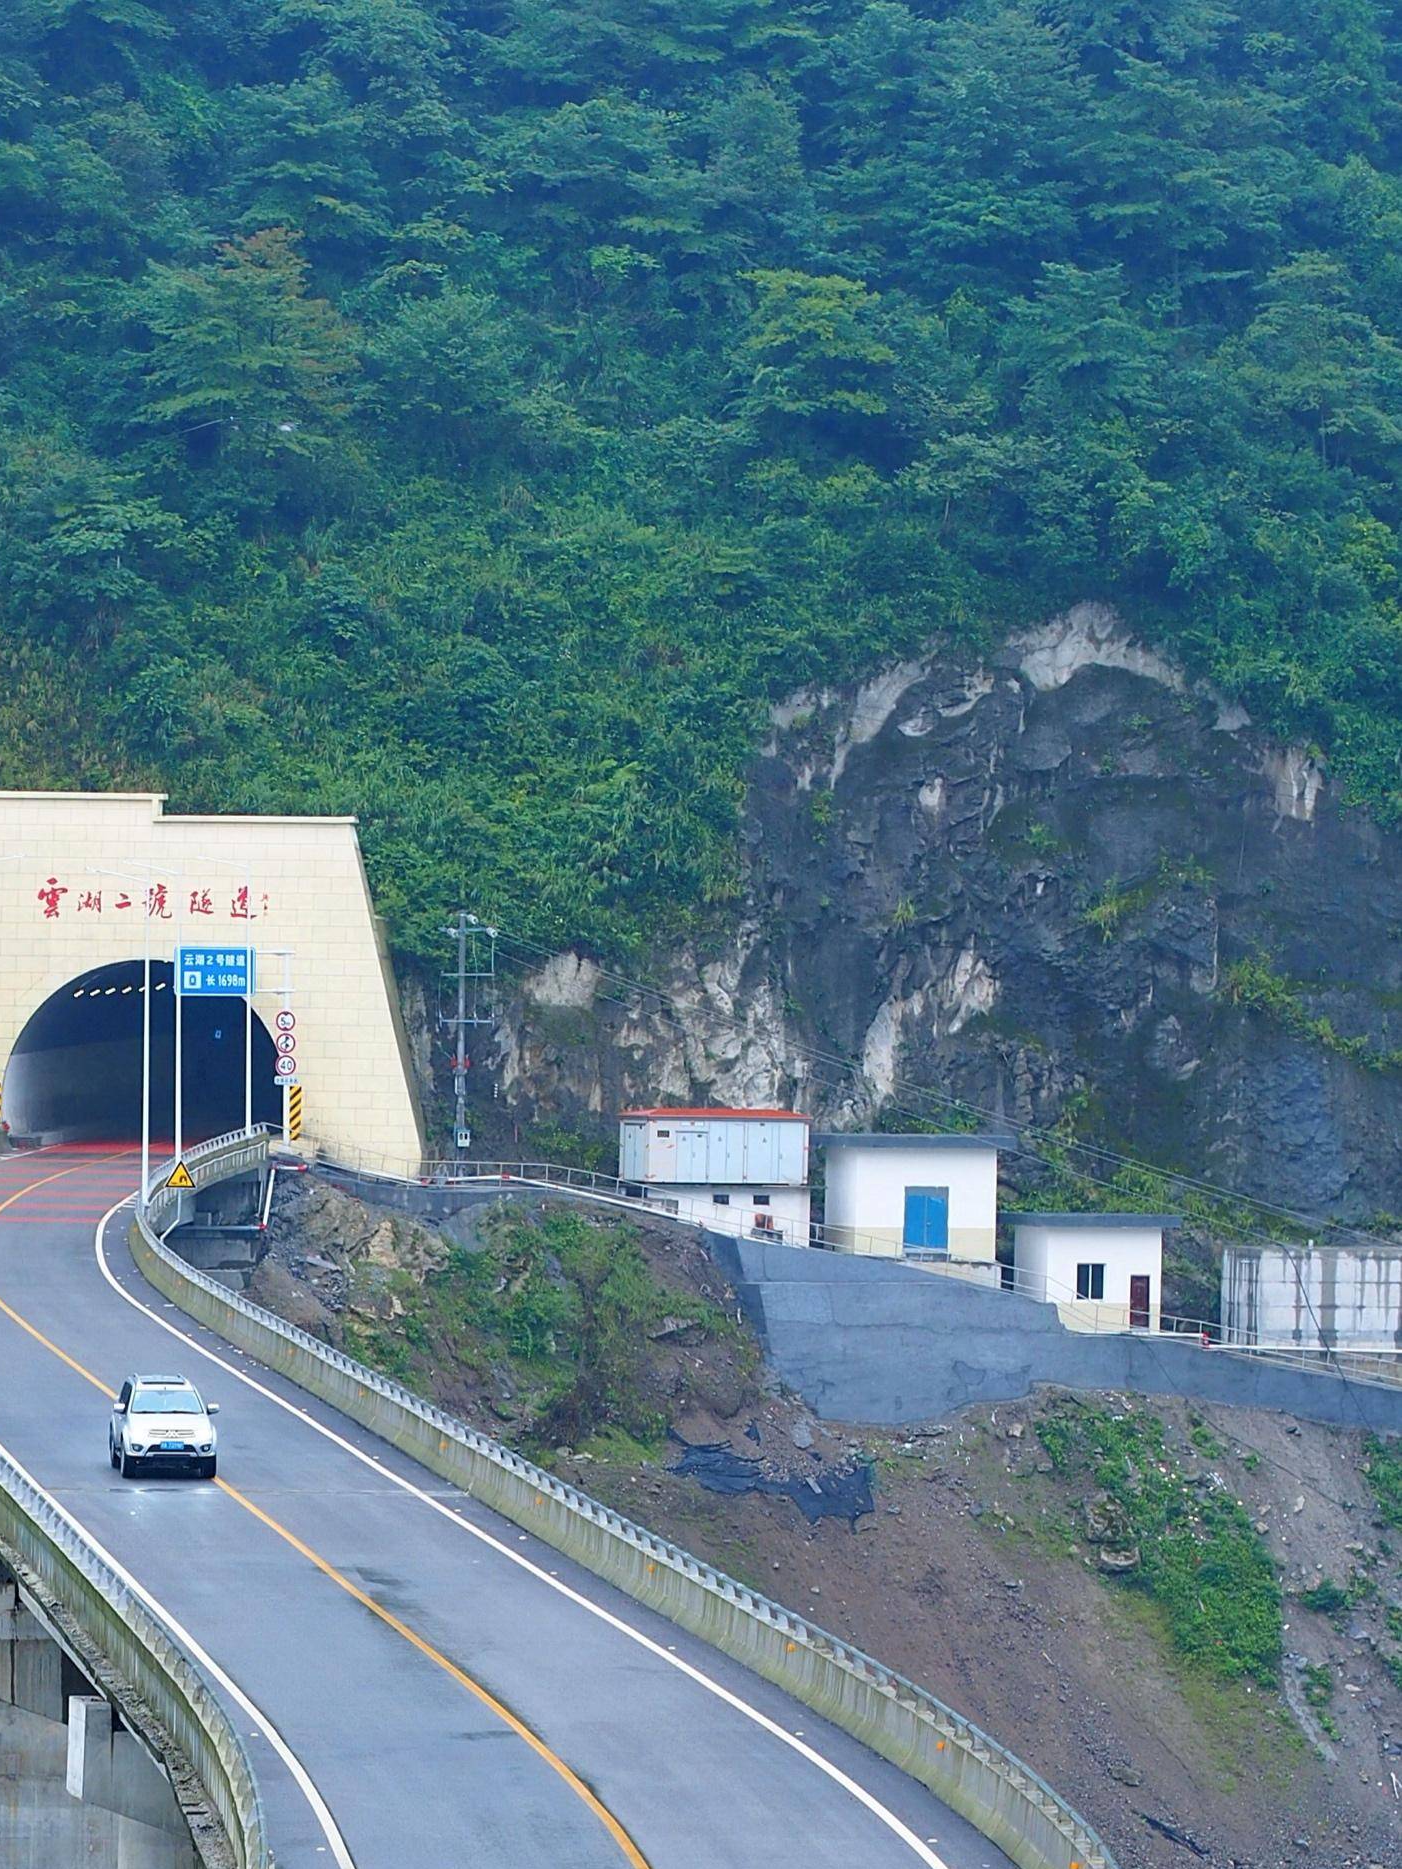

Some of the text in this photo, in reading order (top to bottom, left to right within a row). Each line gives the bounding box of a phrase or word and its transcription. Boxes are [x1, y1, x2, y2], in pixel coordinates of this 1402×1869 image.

[183, 953, 246, 967] 云湖2号隧道
[280, 1060, 293, 1071] 40
